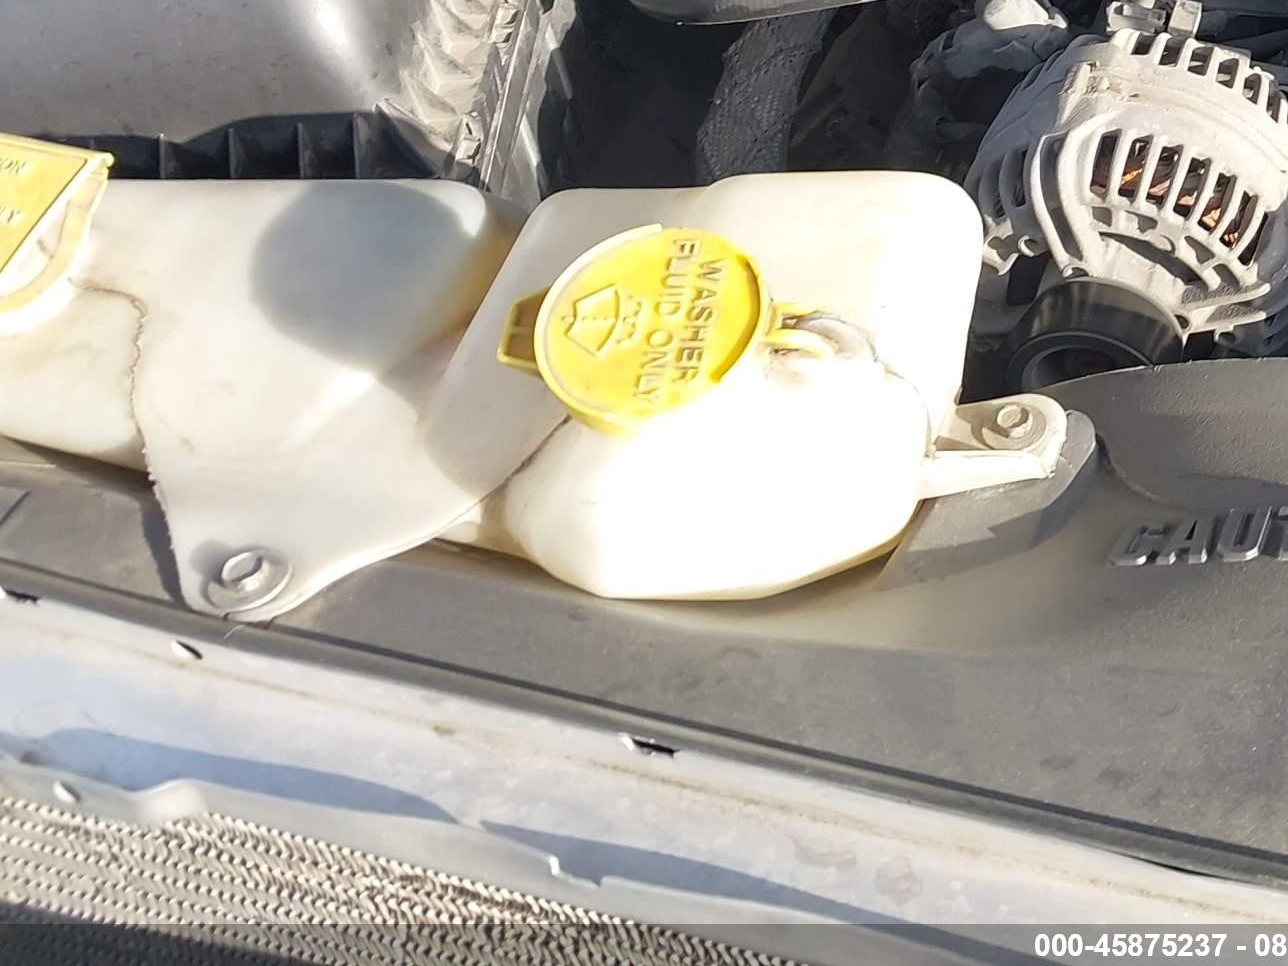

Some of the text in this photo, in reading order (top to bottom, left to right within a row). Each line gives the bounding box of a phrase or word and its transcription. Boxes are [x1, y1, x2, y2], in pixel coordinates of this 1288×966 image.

[632, 237, 698, 404] FLUID ONLY
[671, 257, 727, 384] WASHER
